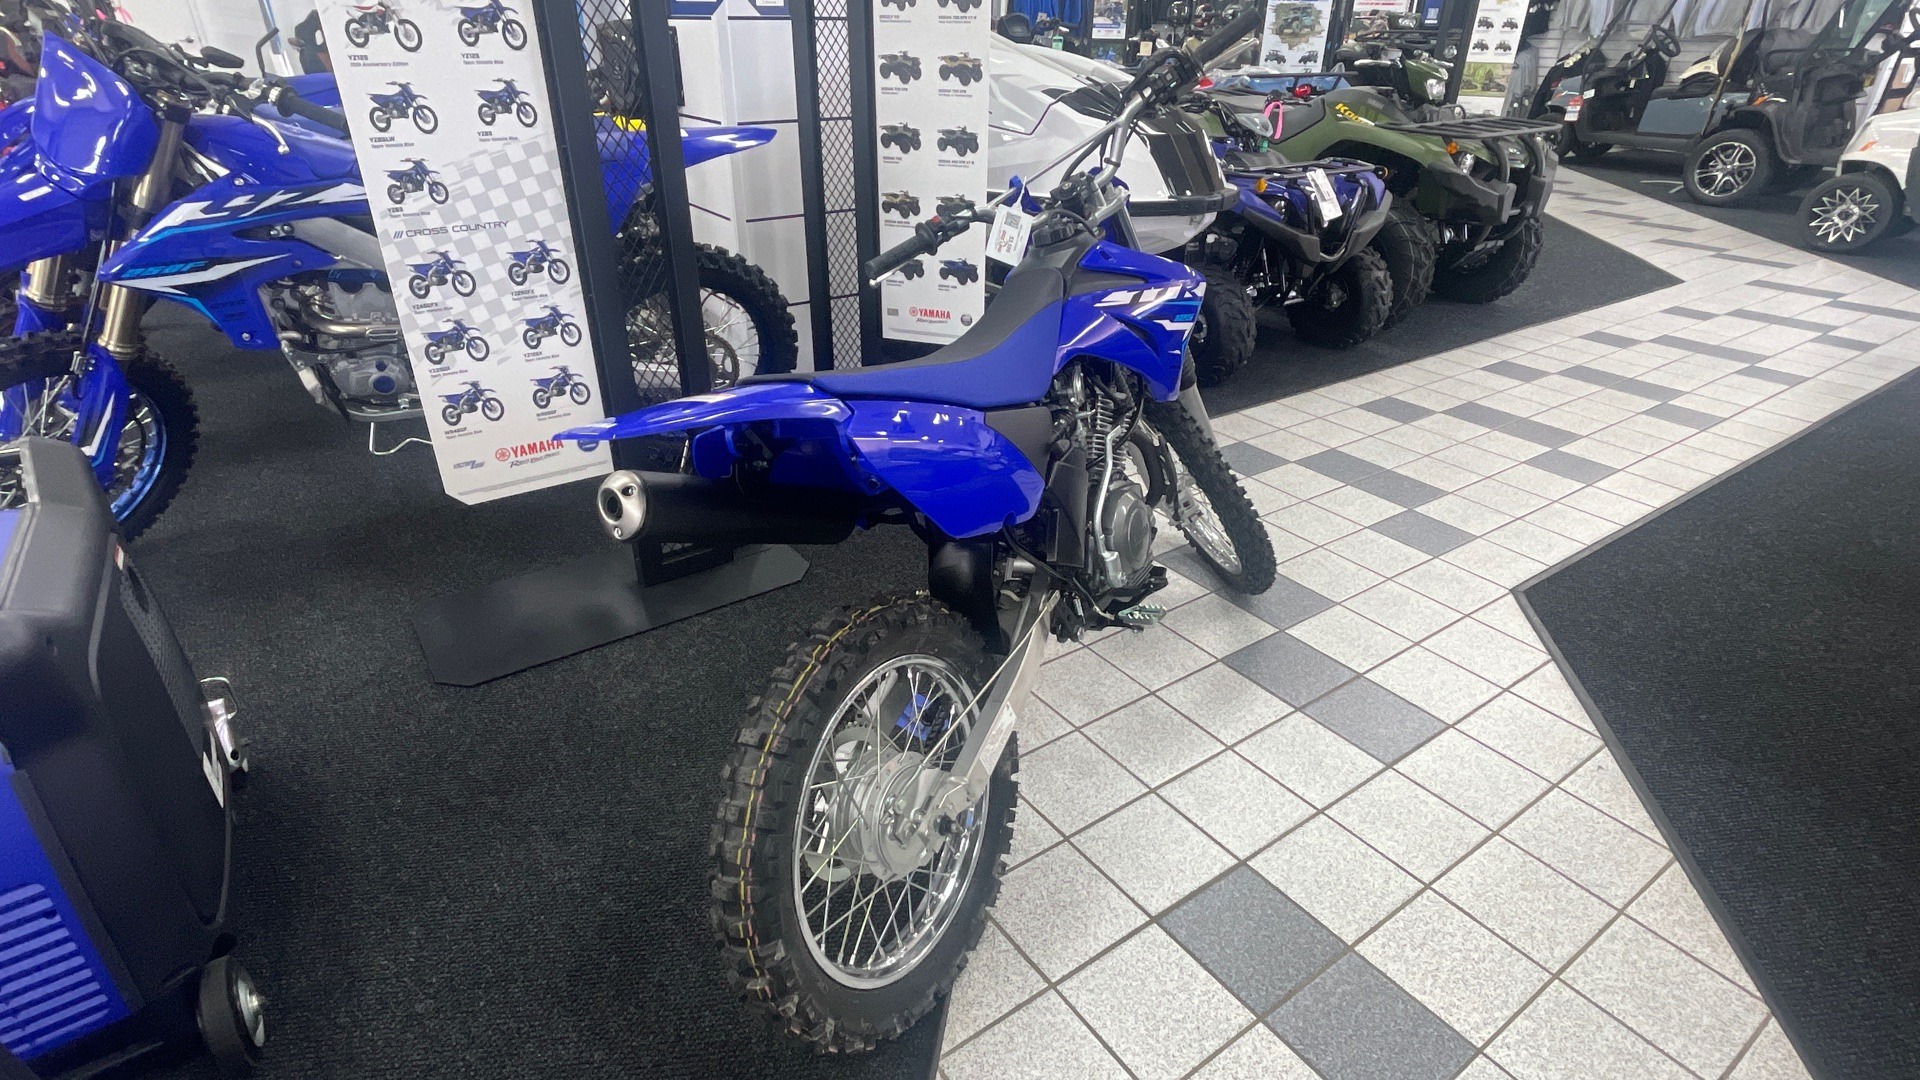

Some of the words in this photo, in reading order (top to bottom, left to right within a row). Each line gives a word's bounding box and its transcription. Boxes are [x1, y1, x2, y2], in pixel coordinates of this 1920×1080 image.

[405, 226, 449, 238] CROSS
[452, 220, 509, 233] COUNTRY
[919, 308, 951, 320] YAMAHA
[511, 439, 564, 458] YAMAHA
